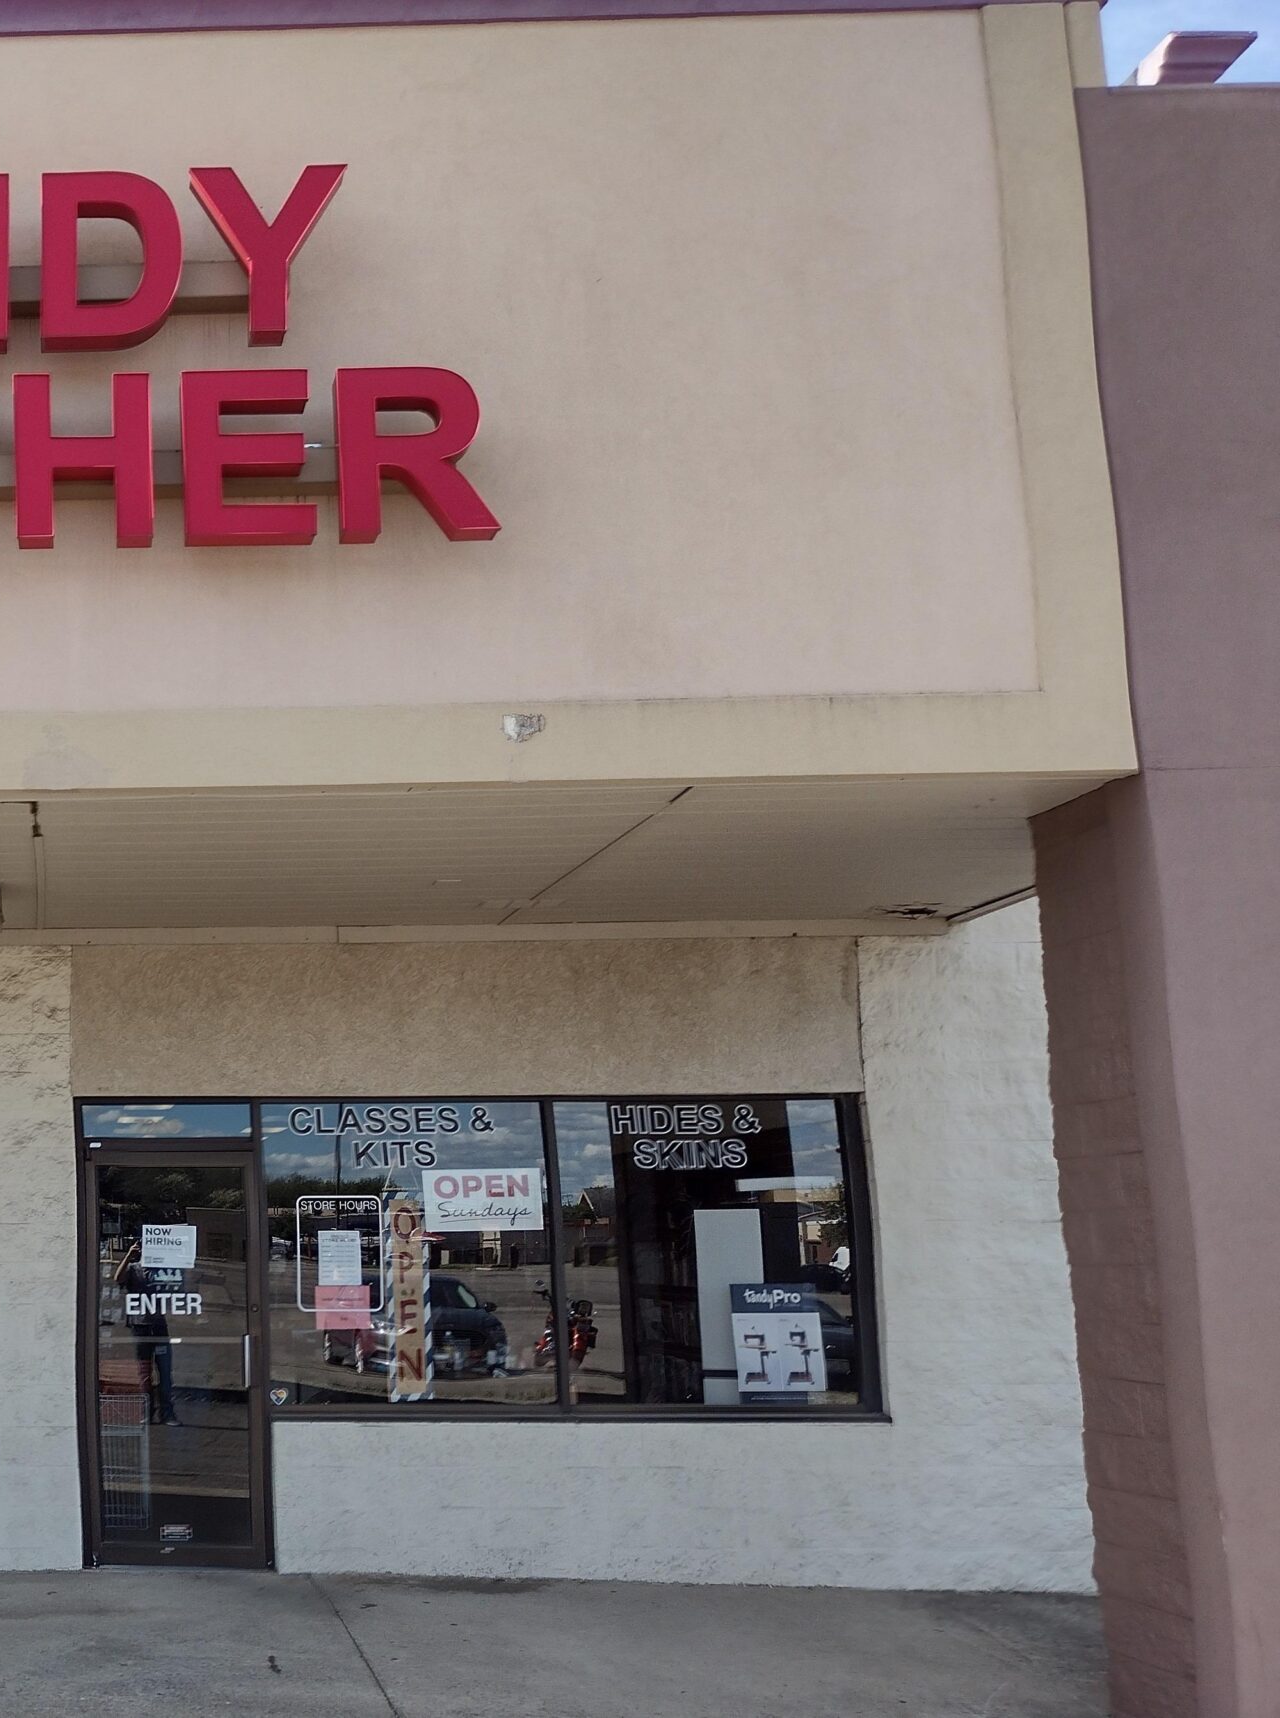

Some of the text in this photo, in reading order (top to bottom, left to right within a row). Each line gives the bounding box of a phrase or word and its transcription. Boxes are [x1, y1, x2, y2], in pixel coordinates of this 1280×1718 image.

[288, 1105, 496, 1136] CLASSES &
[610, 1104, 762, 1135] HIDES &
[352, 1140, 437, 1169] KITS
[633, 1139, 748, 1171] SKINS
[433, 1174, 530, 1200] OPEN
[301, 1200, 377, 1211] STORE HOURS
[437, 1201, 533, 1226] Sundays
[145, 1227, 172, 1236] NOW
[145, 1237, 182, 1246] HIRING
[125, 1293, 202, 1315] ENTER
